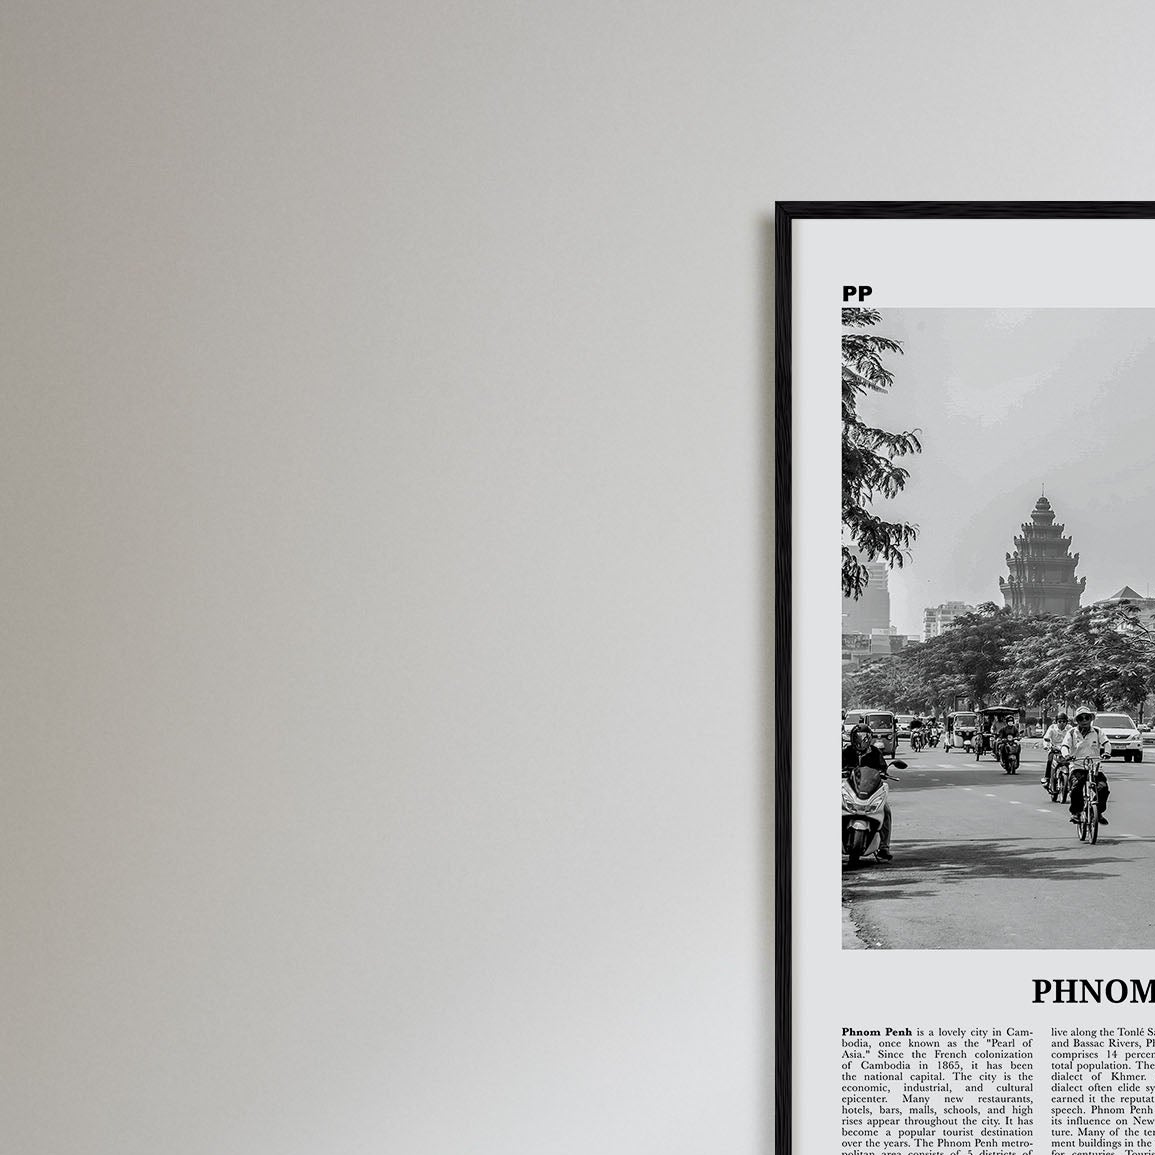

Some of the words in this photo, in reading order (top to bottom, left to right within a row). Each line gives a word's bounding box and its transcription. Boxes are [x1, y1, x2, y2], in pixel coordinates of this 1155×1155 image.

[843, 286, 872, 302] PP
[1051, 1028, 1068, 1036] live
[1070, 1028, 1097, 1039] along
[1100, 1028, 1115, 1036] the
[1117, 1028, 1144, 1036] Tonlé
[842, 1039, 871, 1049] bodia,
[908, 1039, 940, 1048] known
[964, 1039, 979, 1048] the
[1022, 1039, 1033, 1048] of
[1051, 1039, 1069, 1048] and
[1073, 1039, 1104, 1048] Bassac
[1109, 1039, 1142, 1049] Rivers,
[878, 1050, 904, 1059] Since
[912, 1050, 927, 1059] the
[935, 1050, 967, 1059] French
[974, 1050, 1033, 1059] colonization
[1051, 1050, 1099, 1061] comprises
[1107, 1050, 1117, 1059] 14
[841, 1061, 852, 1070] of
[861, 1061, 911, 1070] Cambodia
[919, 1061, 928, 1070] in
[938, 1061, 963, 1071] 1865,
[971, 1061, 978, 1070] it
[986, 1061, 1003, 1070] has
[1010, 1061, 1033, 1070] been
[1051, 1061, 1073, 1070] total
[1077, 1061, 1131, 1072] population.
[1135, 1061, 1155, 1070] The
[842, 1072, 857, 1081] the
[864, 1072, 903, 1081] national
[910, 1072, 945, 1083] capital.
[952, 1072, 972, 1081] The
[979, 1072, 997, 1083] city
[1004, 1072, 1011, 1081] is
[1018, 1072, 1033, 1081] the
[1051, 1072, 1083, 1081] dialect
[1091, 1072, 1102, 1081] of
[1111, 1072, 1146, 1081] Khmer.
[841, 1083, 890, 1093] economic,
[904, 1083, 952, 1093] industrial,
[965, 1083, 983, 1092] and
[996, 1083, 1033, 1092] cultural
[1051, 1083, 1083, 1092] dialect
[1088, 1083, 1112, 1092] often
[1117, 1083, 1140, 1092] elide
[841, 1095, 888, 1106] epicenter.
[902, 1095, 930, 1106] Many
[978, 1095, 1033, 1105] restaurants,
[1051, 1095, 1084, 1103] earned
[1089, 1095, 1096, 1103] it
[1100, 1095, 1115, 1103] the
[842, 1106, 873, 1116] hotels,
[879, 1106, 902, 1116] bars,
[909, 1106, 937, 1116] malls,
[943, 1106, 980, 1116] schools,
[987, 1106, 1005, 1114] and
[1012, 1106, 1033, 1117] high
[1051, 1117, 1062, 1125] its
[1067, 1117, 1111, 1125] influence
[1133, 1117, 1155, 1125] New
[842, 1128, 878, 1137] become
[898, 1128, 936, 1139] popular
[943, 1128, 973, 1137] tourist
[980, 1128, 1033, 1137] destination
